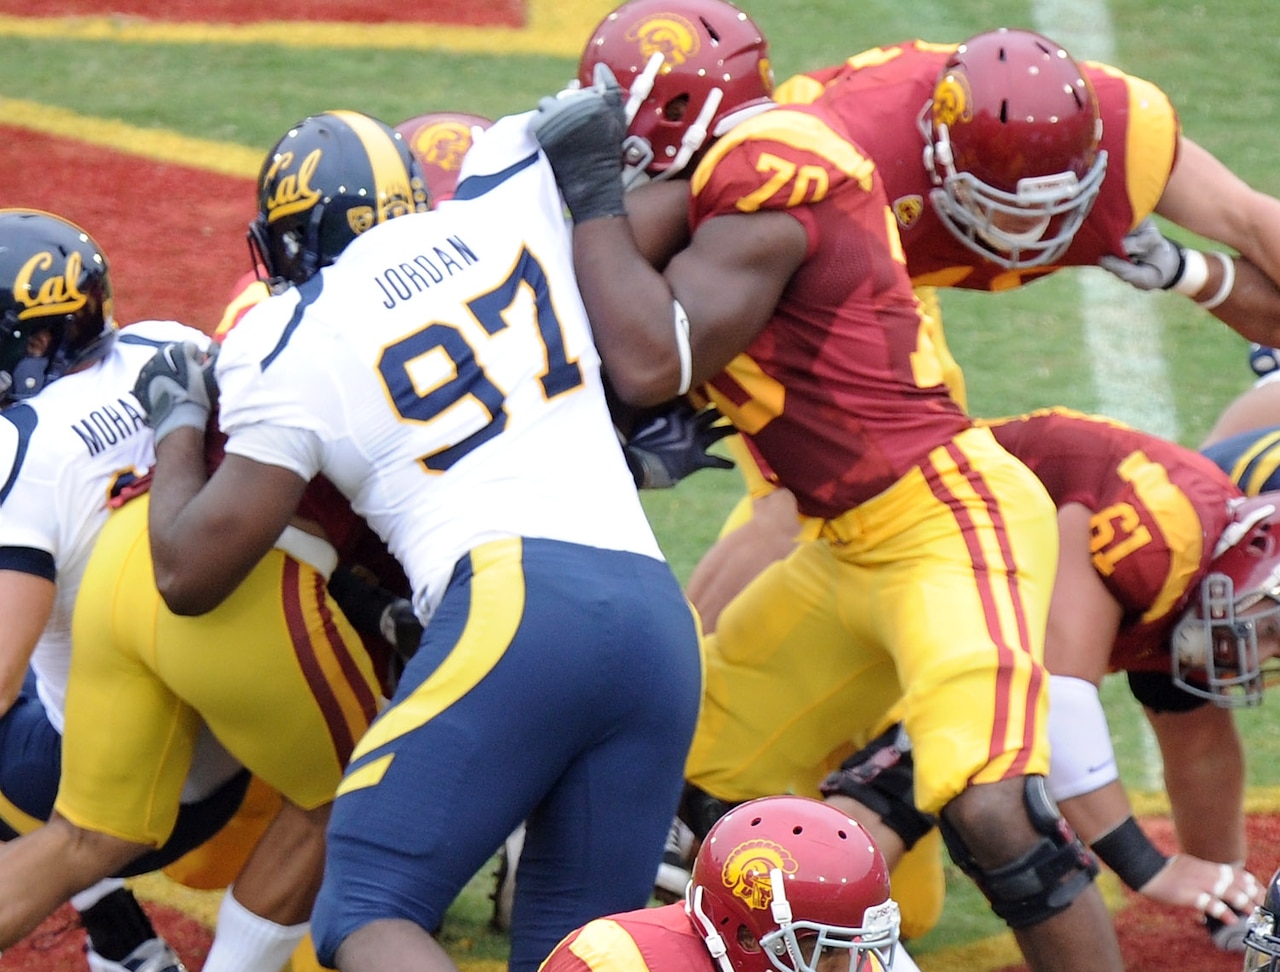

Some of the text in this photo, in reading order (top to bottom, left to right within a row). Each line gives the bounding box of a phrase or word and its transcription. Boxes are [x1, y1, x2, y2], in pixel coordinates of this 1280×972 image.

[264, 149, 323, 222] Cal
[736, 151, 829, 213] 70
[13, 251, 87, 320] Cal
[374, 233, 479, 310] JORDAN
[374, 240, 587, 476] 97
[71, 388, 149, 457] MOHA
[1089, 501, 1153, 577] 61
